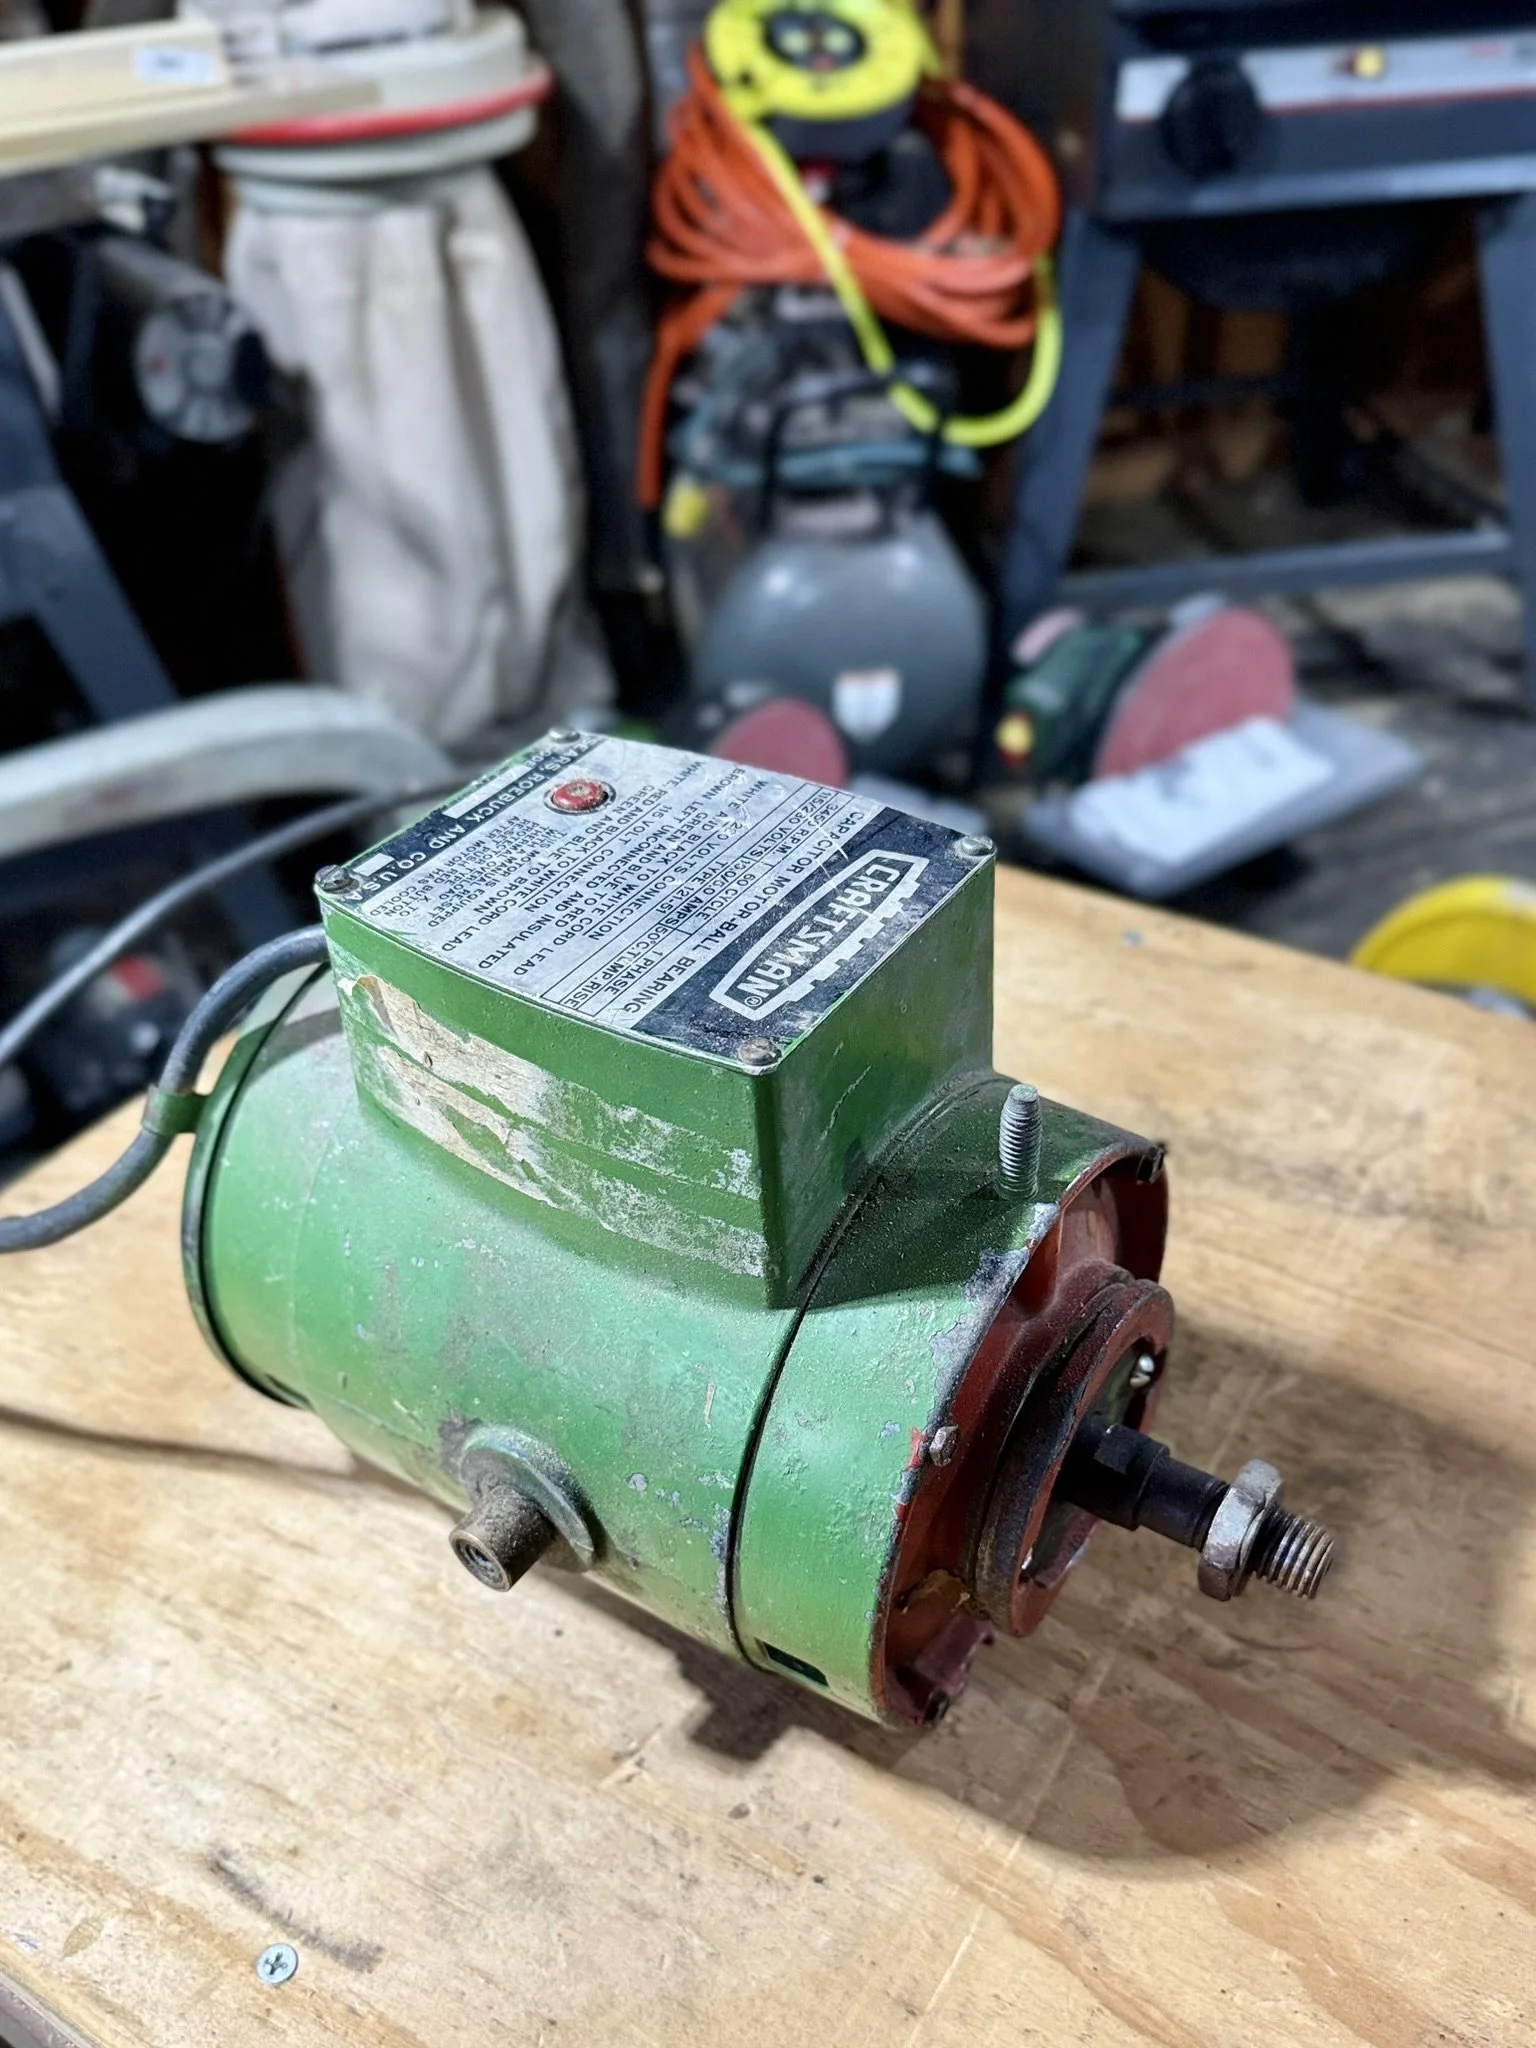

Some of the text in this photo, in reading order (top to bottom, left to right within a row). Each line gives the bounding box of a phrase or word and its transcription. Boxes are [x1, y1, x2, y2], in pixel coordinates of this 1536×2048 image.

[462, 771, 548, 824] ROEBUCK
[638, 788, 669, 806] RED
[724, 779, 771, 809] WHITE
[613, 805, 646, 825] AND
[747, 790, 835, 858] 115/230 VOLTS
[423, 823, 470, 850] AND
[471, 783, 657, 914] GREEN AND BLUE TO BROWN
[472, 821, 541, 866] PROTECTOR
[525, 827, 559, 848] WITH
[573, 824, 620, 854] BLACK
[654, 833, 702, 866] BLACK
[770, 828, 811, 856] R.P.M.
[366, 815, 523, 918] AFTER MOTOR HAS COOLED
[382, 818, 531, 918] RE-SET PUSH RED BUTTON
[436, 824, 550, 901] THERMAL OVERLOAD
[468, 855, 519, 888] MANUAL
[474, 767, 748, 970] BROWN LEFT UNCONNECTED AND INSULATED
[497, 849, 542, 878] MOTOR
[521, 804, 674, 913] 115 VOLT CONNECTION
[552, 811, 710, 928] GREEN AND BLUE TO RED
[554, 854, 580, 869] TO
[671, 840, 720, 874] VOLTS
[442, 865, 477, 887] TYPE
[483, 877, 501, 888] IS
[511, 867, 560, 899] WHITE
[633, 866, 660, 882] TO
[654, 859, 728, 914] TYPE 121-51
[396, 904, 419, 918] TO
[424, 887, 472, 919] RE-SET
[425, 887, 487, 928] EQUIPPED
[474, 897, 519, 926] CORD
[586, 874, 678, 941] CONNECTION
[589, 882, 639, 916] WHITE
[662, 895, 707, 926] AMPS
[693, 872, 758, 920] 60 CYCLE
[619, 810, 867, 1015] CAPACITOR MOTOR-BALL BEARING
[438, 924, 481, 953] LEAD
[549, 915, 595, 947] CORD
[510, 946, 554, 976] LEAD
[602, 948, 665, 996] 1 PHASE
